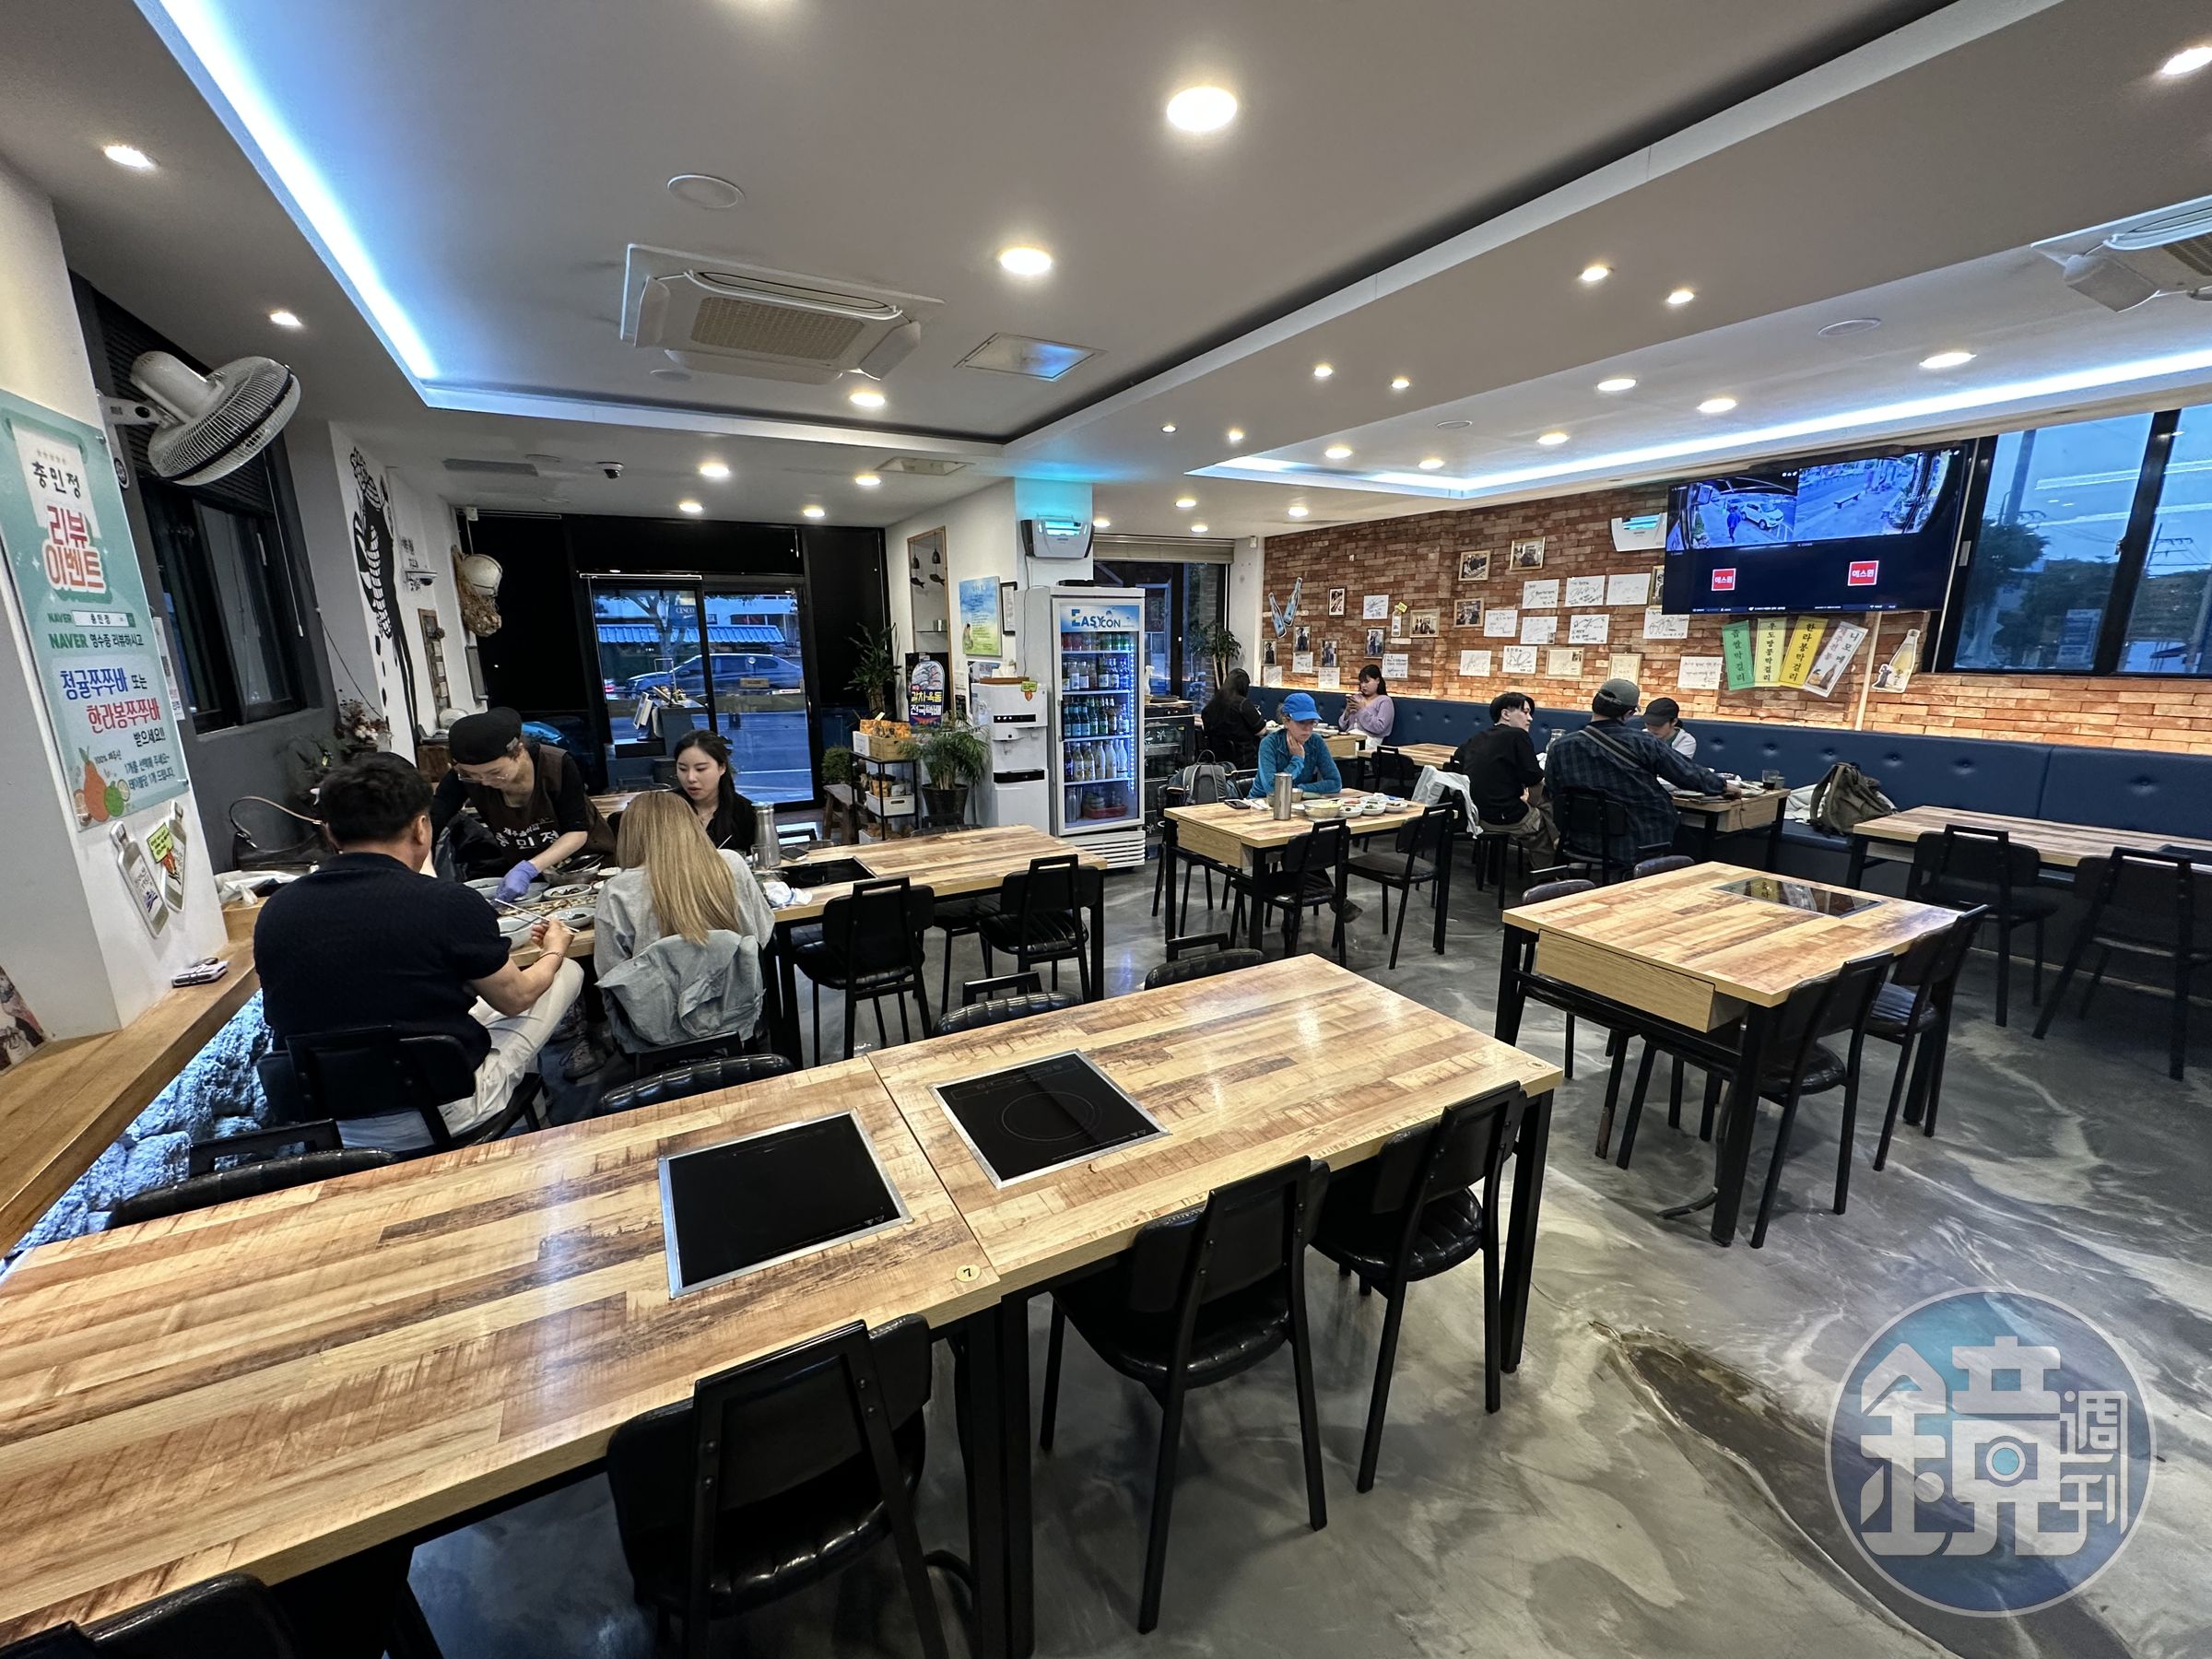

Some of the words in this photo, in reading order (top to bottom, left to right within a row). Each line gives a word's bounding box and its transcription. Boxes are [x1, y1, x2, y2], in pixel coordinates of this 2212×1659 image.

[31, 461, 81, 500] 충민정
[47, 505, 88, 548] 리뷰
[46, 545, 104, 588] 이벤트
[47, 613, 73, 623] NAVER
[90, 613, 111, 625] 충민정
[48, 633, 88, 649] NAVER
[89, 634, 111, 648] 영수증
[112, 634, 145, 648] 리뷰하시고
[1789, 623, 1816, 681] 한라봉막걸리
[60, 667, 129, 700] 청귤쭈쭈바
[131, 674, 147, 689] 또는
[87, 698, 161, 734] 한라봉쭈쭈바
[911, 704, 942, 716] 전국택배
[133, 727, 166, 747] 받으세요!!
[963, 1268, 971, 1277] 7
